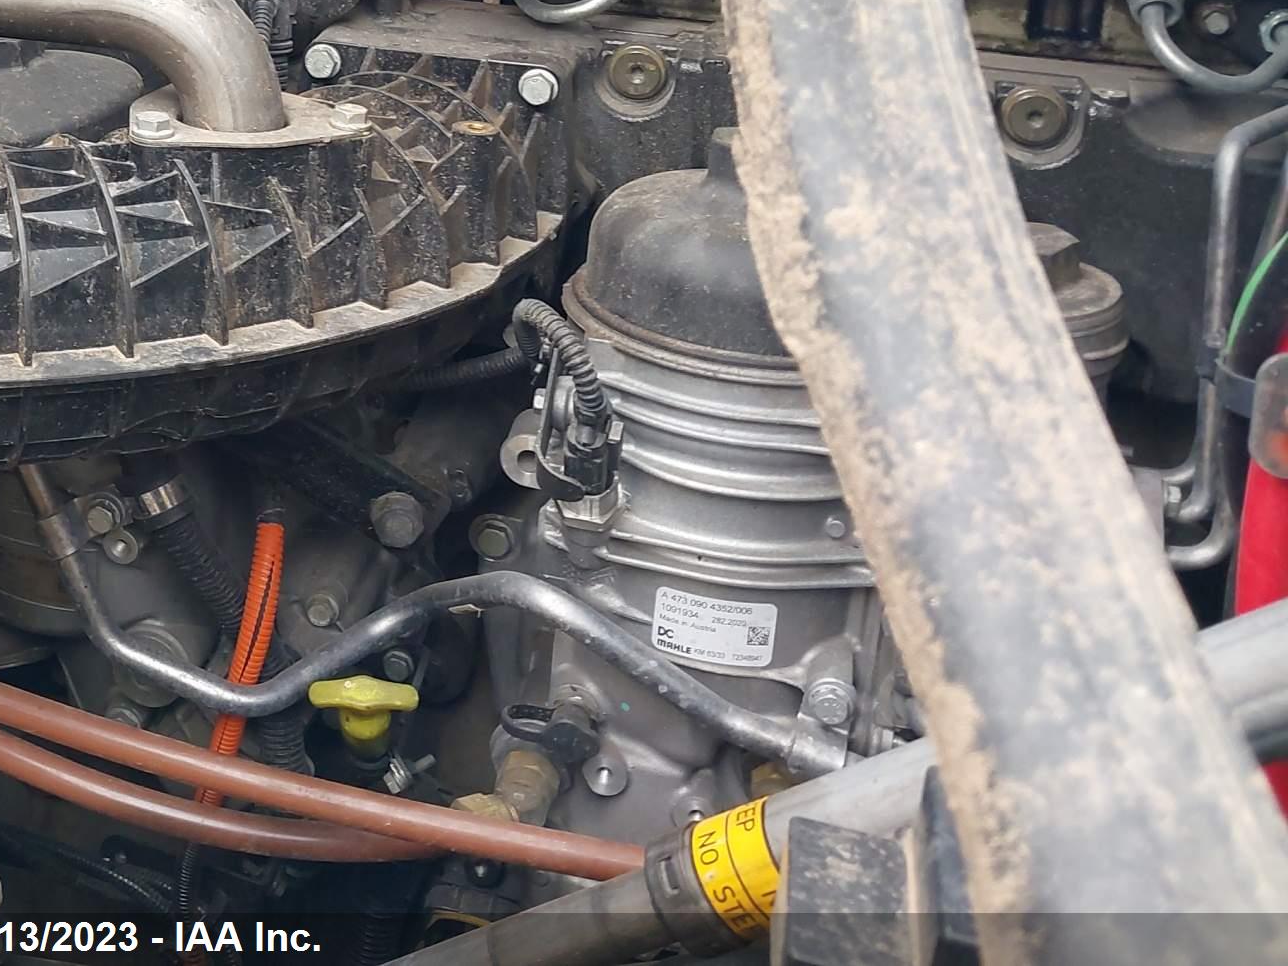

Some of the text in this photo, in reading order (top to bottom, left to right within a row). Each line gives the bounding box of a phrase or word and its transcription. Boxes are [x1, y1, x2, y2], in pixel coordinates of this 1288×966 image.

[661, 591, 668, 599] A
[671, 594, 688, 605] 473
[690, 598, 707, 609] 090
[659, 613, 679, 624] Made
[690, 622, 717, 633] Austria
[657, 626, 674, 639] DC
[657, 638, 692, 654] MAHLE
[698, 830, 719, 865] NO
